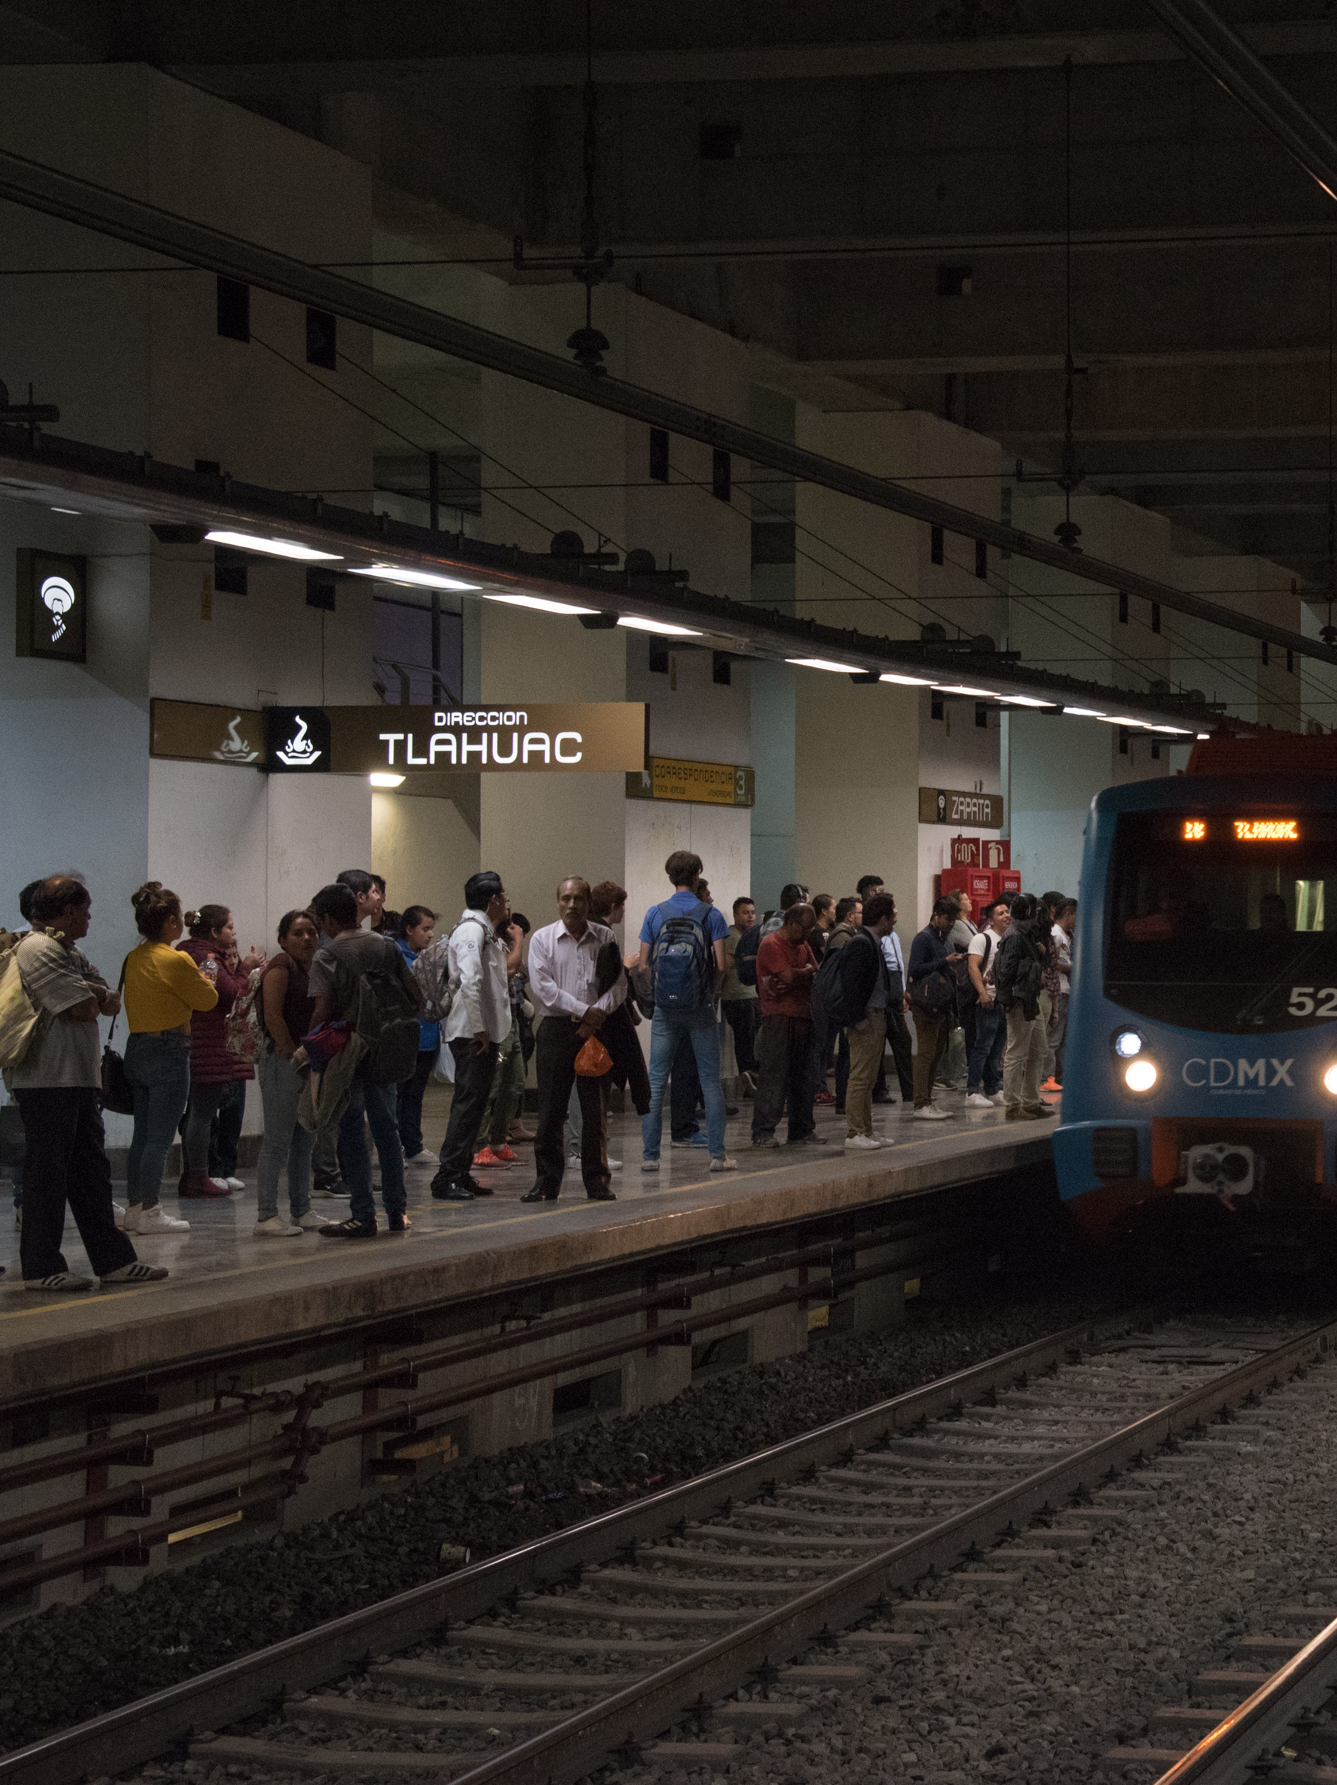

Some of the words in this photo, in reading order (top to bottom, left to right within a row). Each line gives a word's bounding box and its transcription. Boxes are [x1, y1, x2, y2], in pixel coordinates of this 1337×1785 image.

[434, 711, 528, 726] DIRECCION
[379, 731, 583, 765] TLAHUAC
[654, 764, 733, 785] CORRESPONDENCIA
[736, 770, 746, 795] 3
[951, 796, 992, 822] ZAPATA
[1181, 1057, 1295, 1087] CDMX
